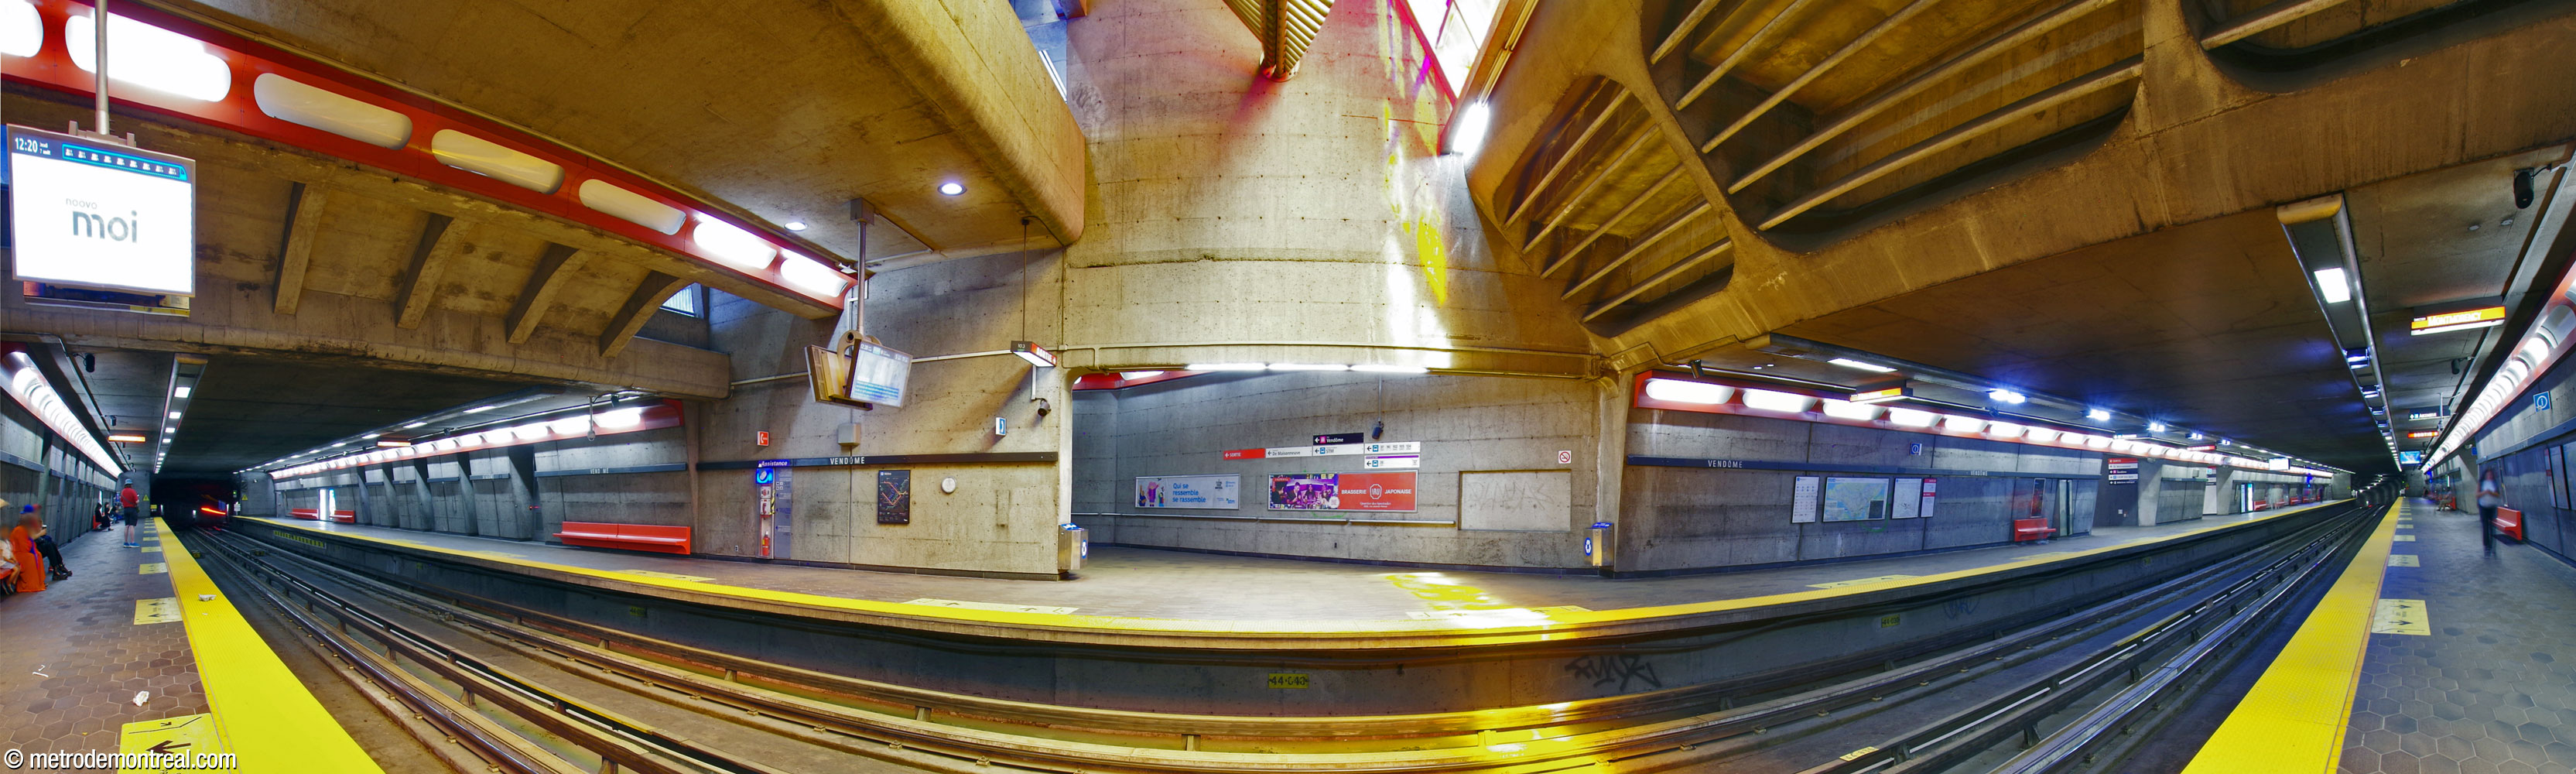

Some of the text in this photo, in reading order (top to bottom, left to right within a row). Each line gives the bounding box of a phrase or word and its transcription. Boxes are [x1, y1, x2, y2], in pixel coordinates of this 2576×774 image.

[15, 137, 38, 153] 12:20
[66, 197, 97, 210] noovo
[72, 210, 138, 243] moi
[2427, 311, 2482, 327] MONTMORENCY
[1708, 460, 1743, 468] VENDÔME
